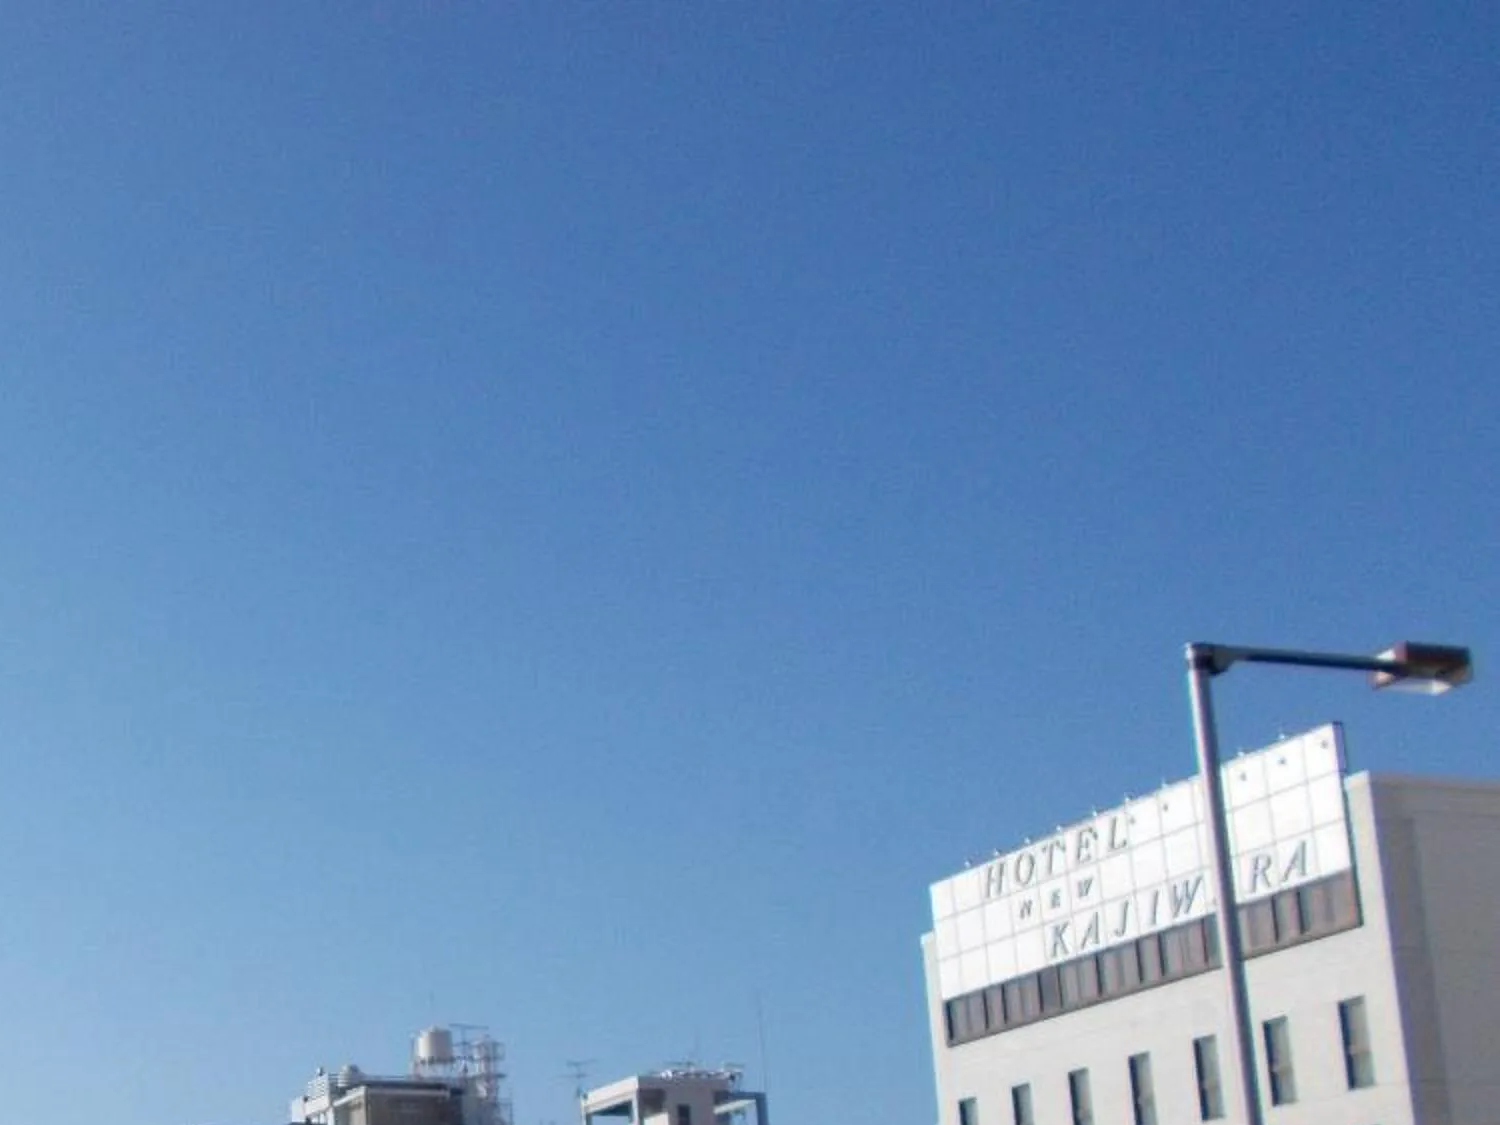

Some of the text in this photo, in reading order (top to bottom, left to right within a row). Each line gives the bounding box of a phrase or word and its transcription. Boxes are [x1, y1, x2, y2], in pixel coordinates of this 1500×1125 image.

[986, 815, 1128, 899] HOTEL
[1019, 876, 1094, 920] NEW
[1050, 839, 1310, 958] KAJIWRA
